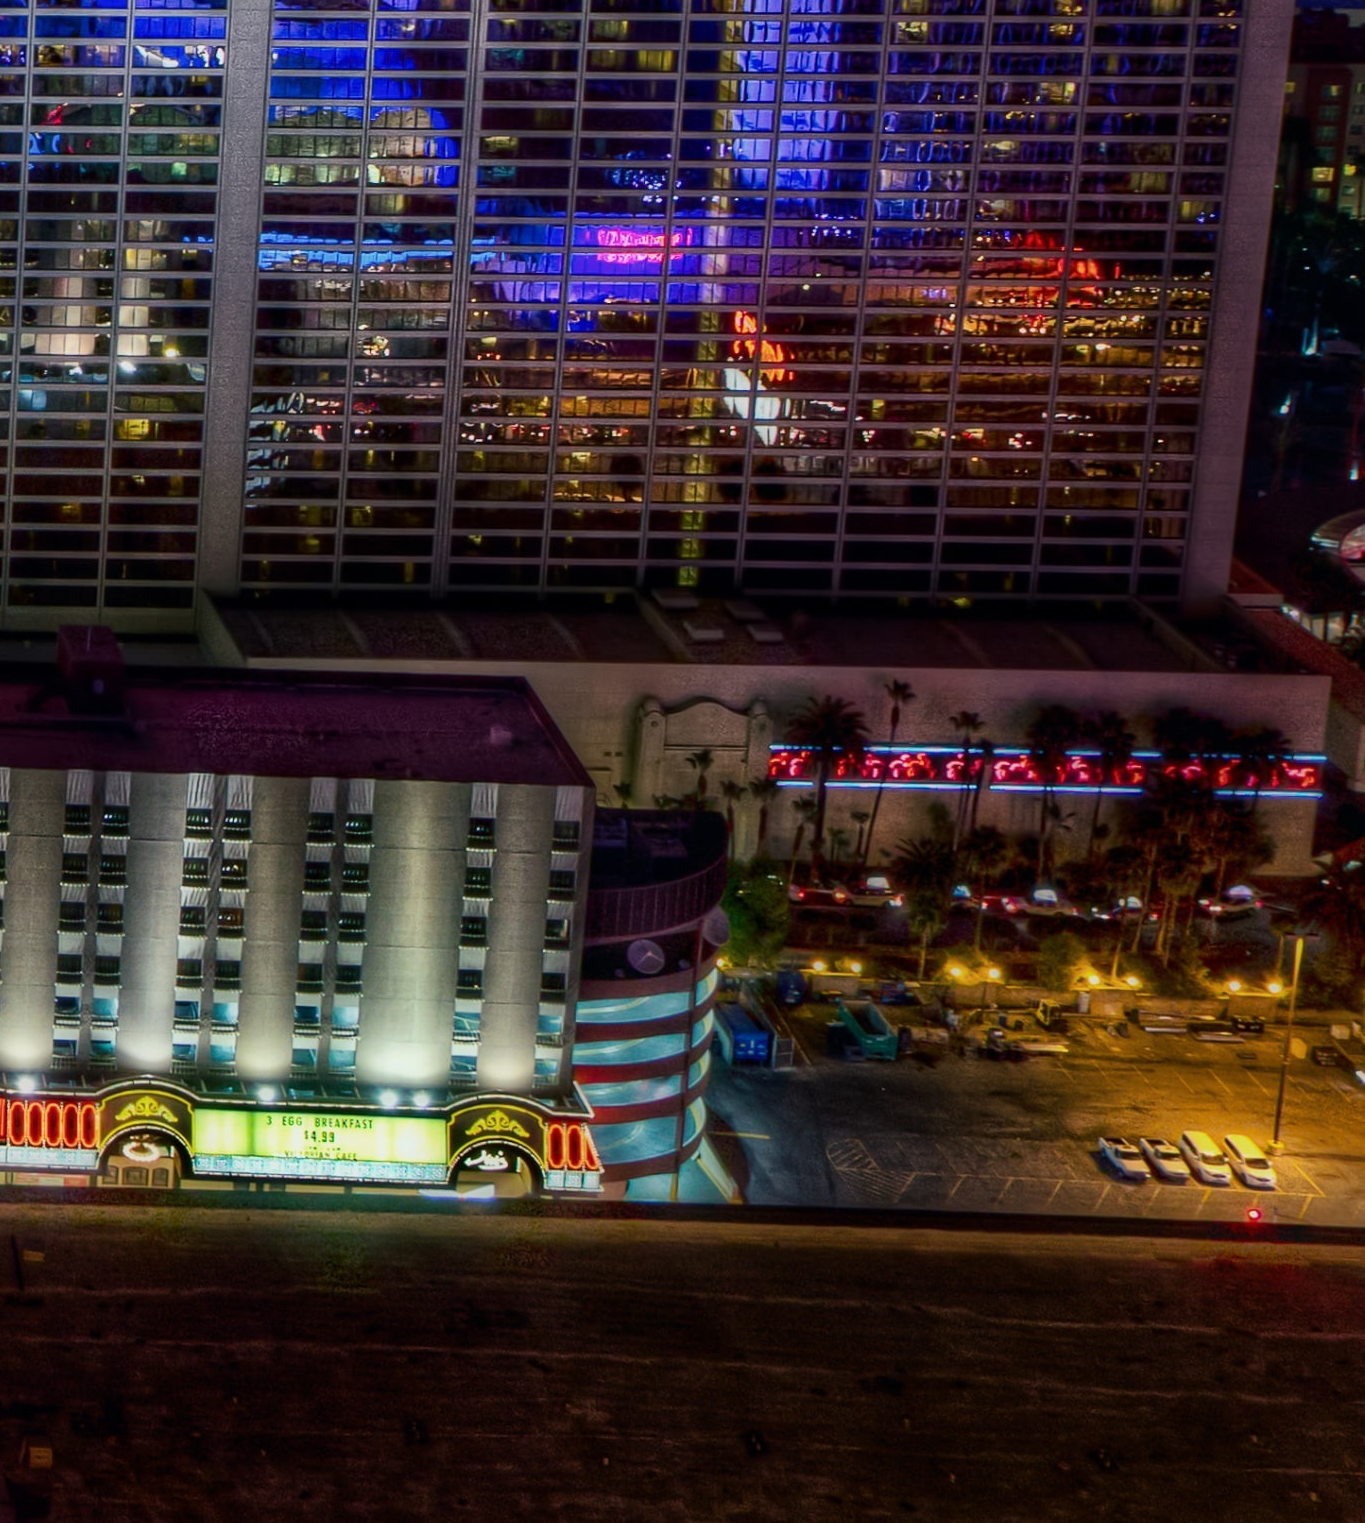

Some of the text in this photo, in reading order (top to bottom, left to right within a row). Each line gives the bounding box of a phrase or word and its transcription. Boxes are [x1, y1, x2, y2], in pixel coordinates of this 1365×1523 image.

[266, 1115, 374, 1130] 3 EGG BREAKFAST
[304, 1129, 335, 1143] $4.99
